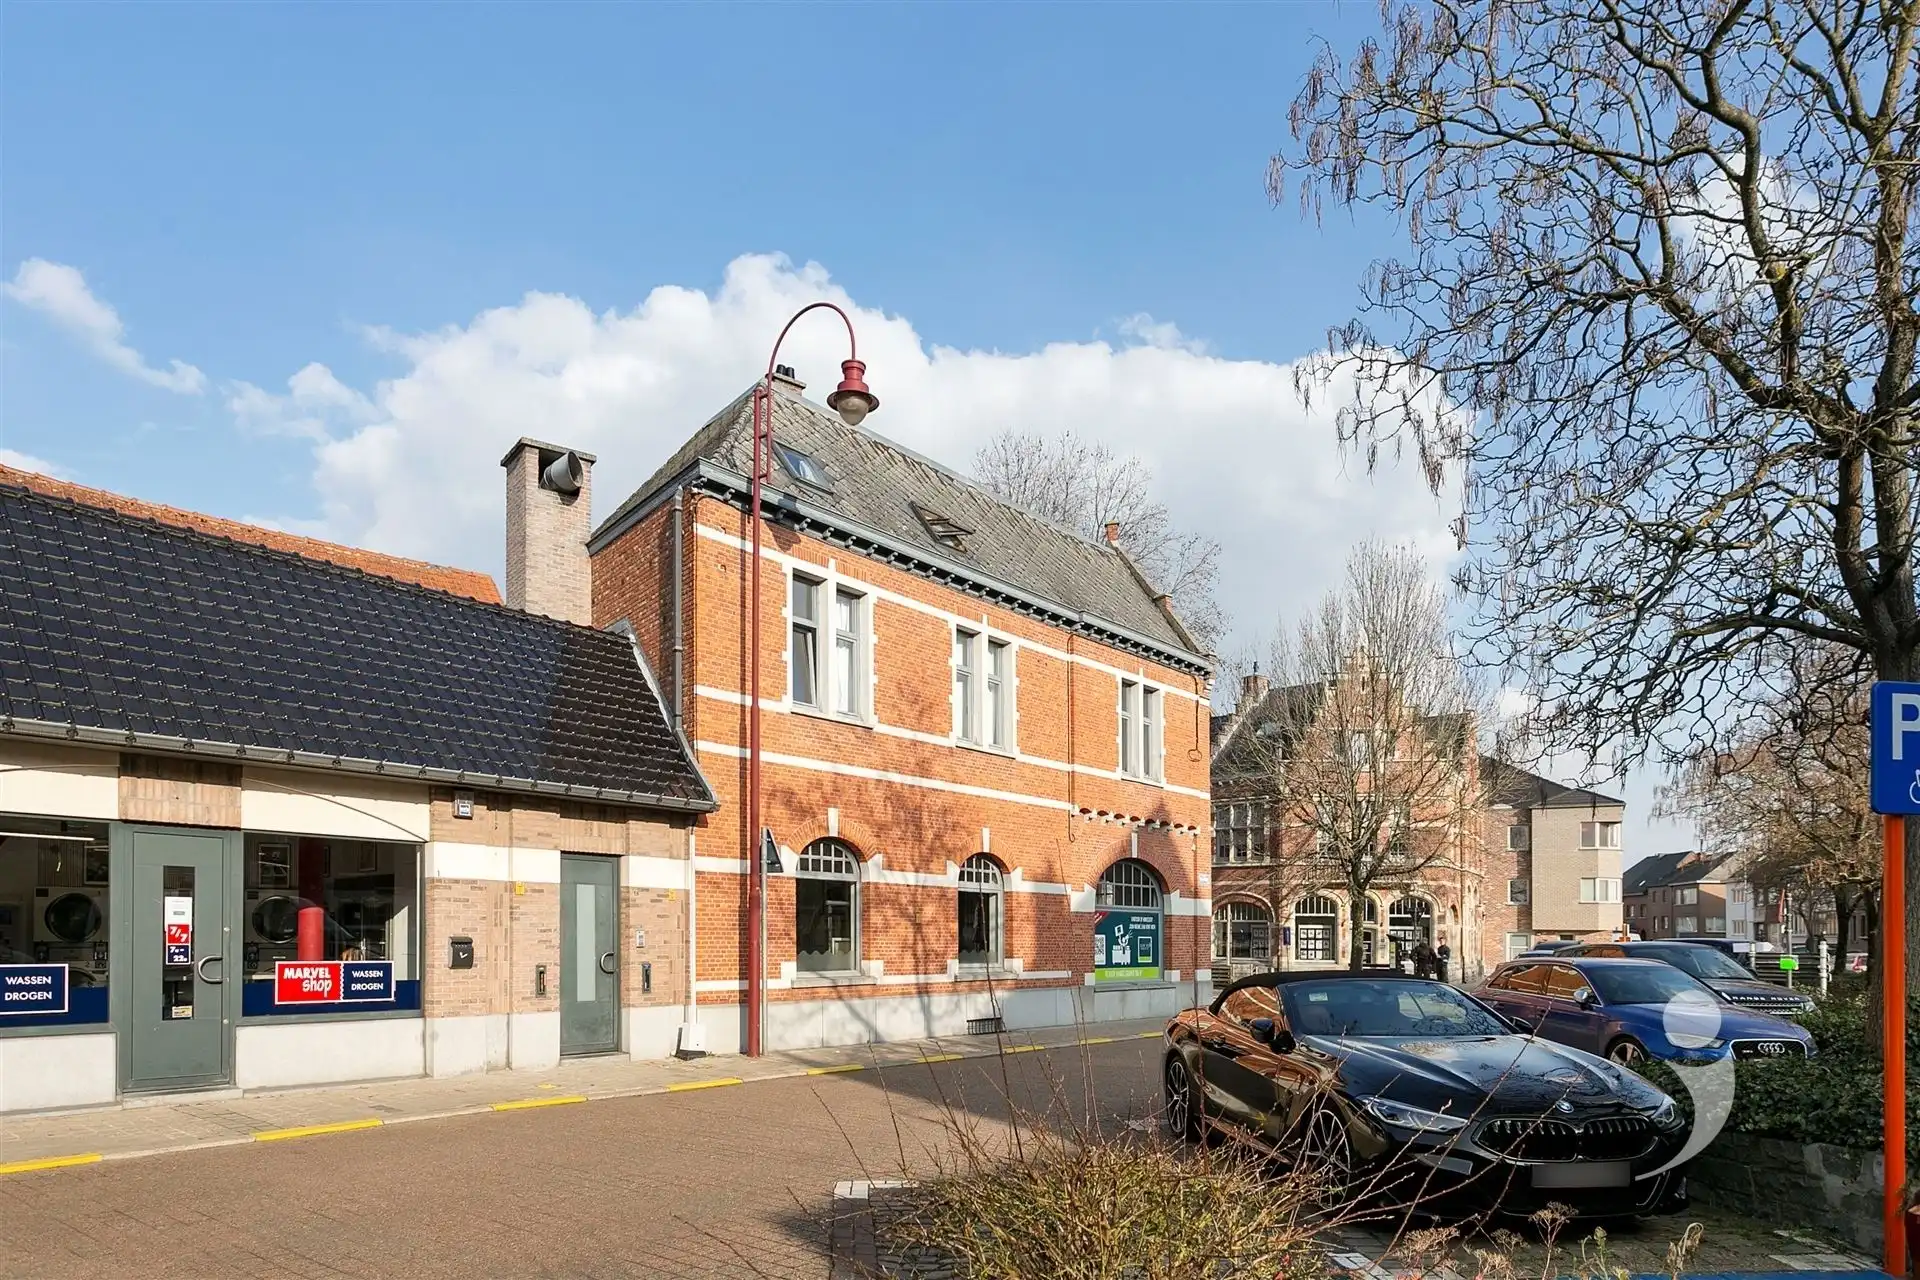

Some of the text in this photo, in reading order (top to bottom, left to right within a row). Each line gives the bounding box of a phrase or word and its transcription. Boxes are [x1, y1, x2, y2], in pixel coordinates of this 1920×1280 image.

[1891, 692, 1920, 761] P
[169, 926, 188, 943] 7/7
[284, 967, 331, 979] MARVEL
[352, 970, 383, 978] WASSEN
[5, 975, 52, 985] WASSEN
[302, 977, 332, 998] shop
[351, 983, 384, 991] DROGEN
[5, 991, 52, 1001] DROGEN
